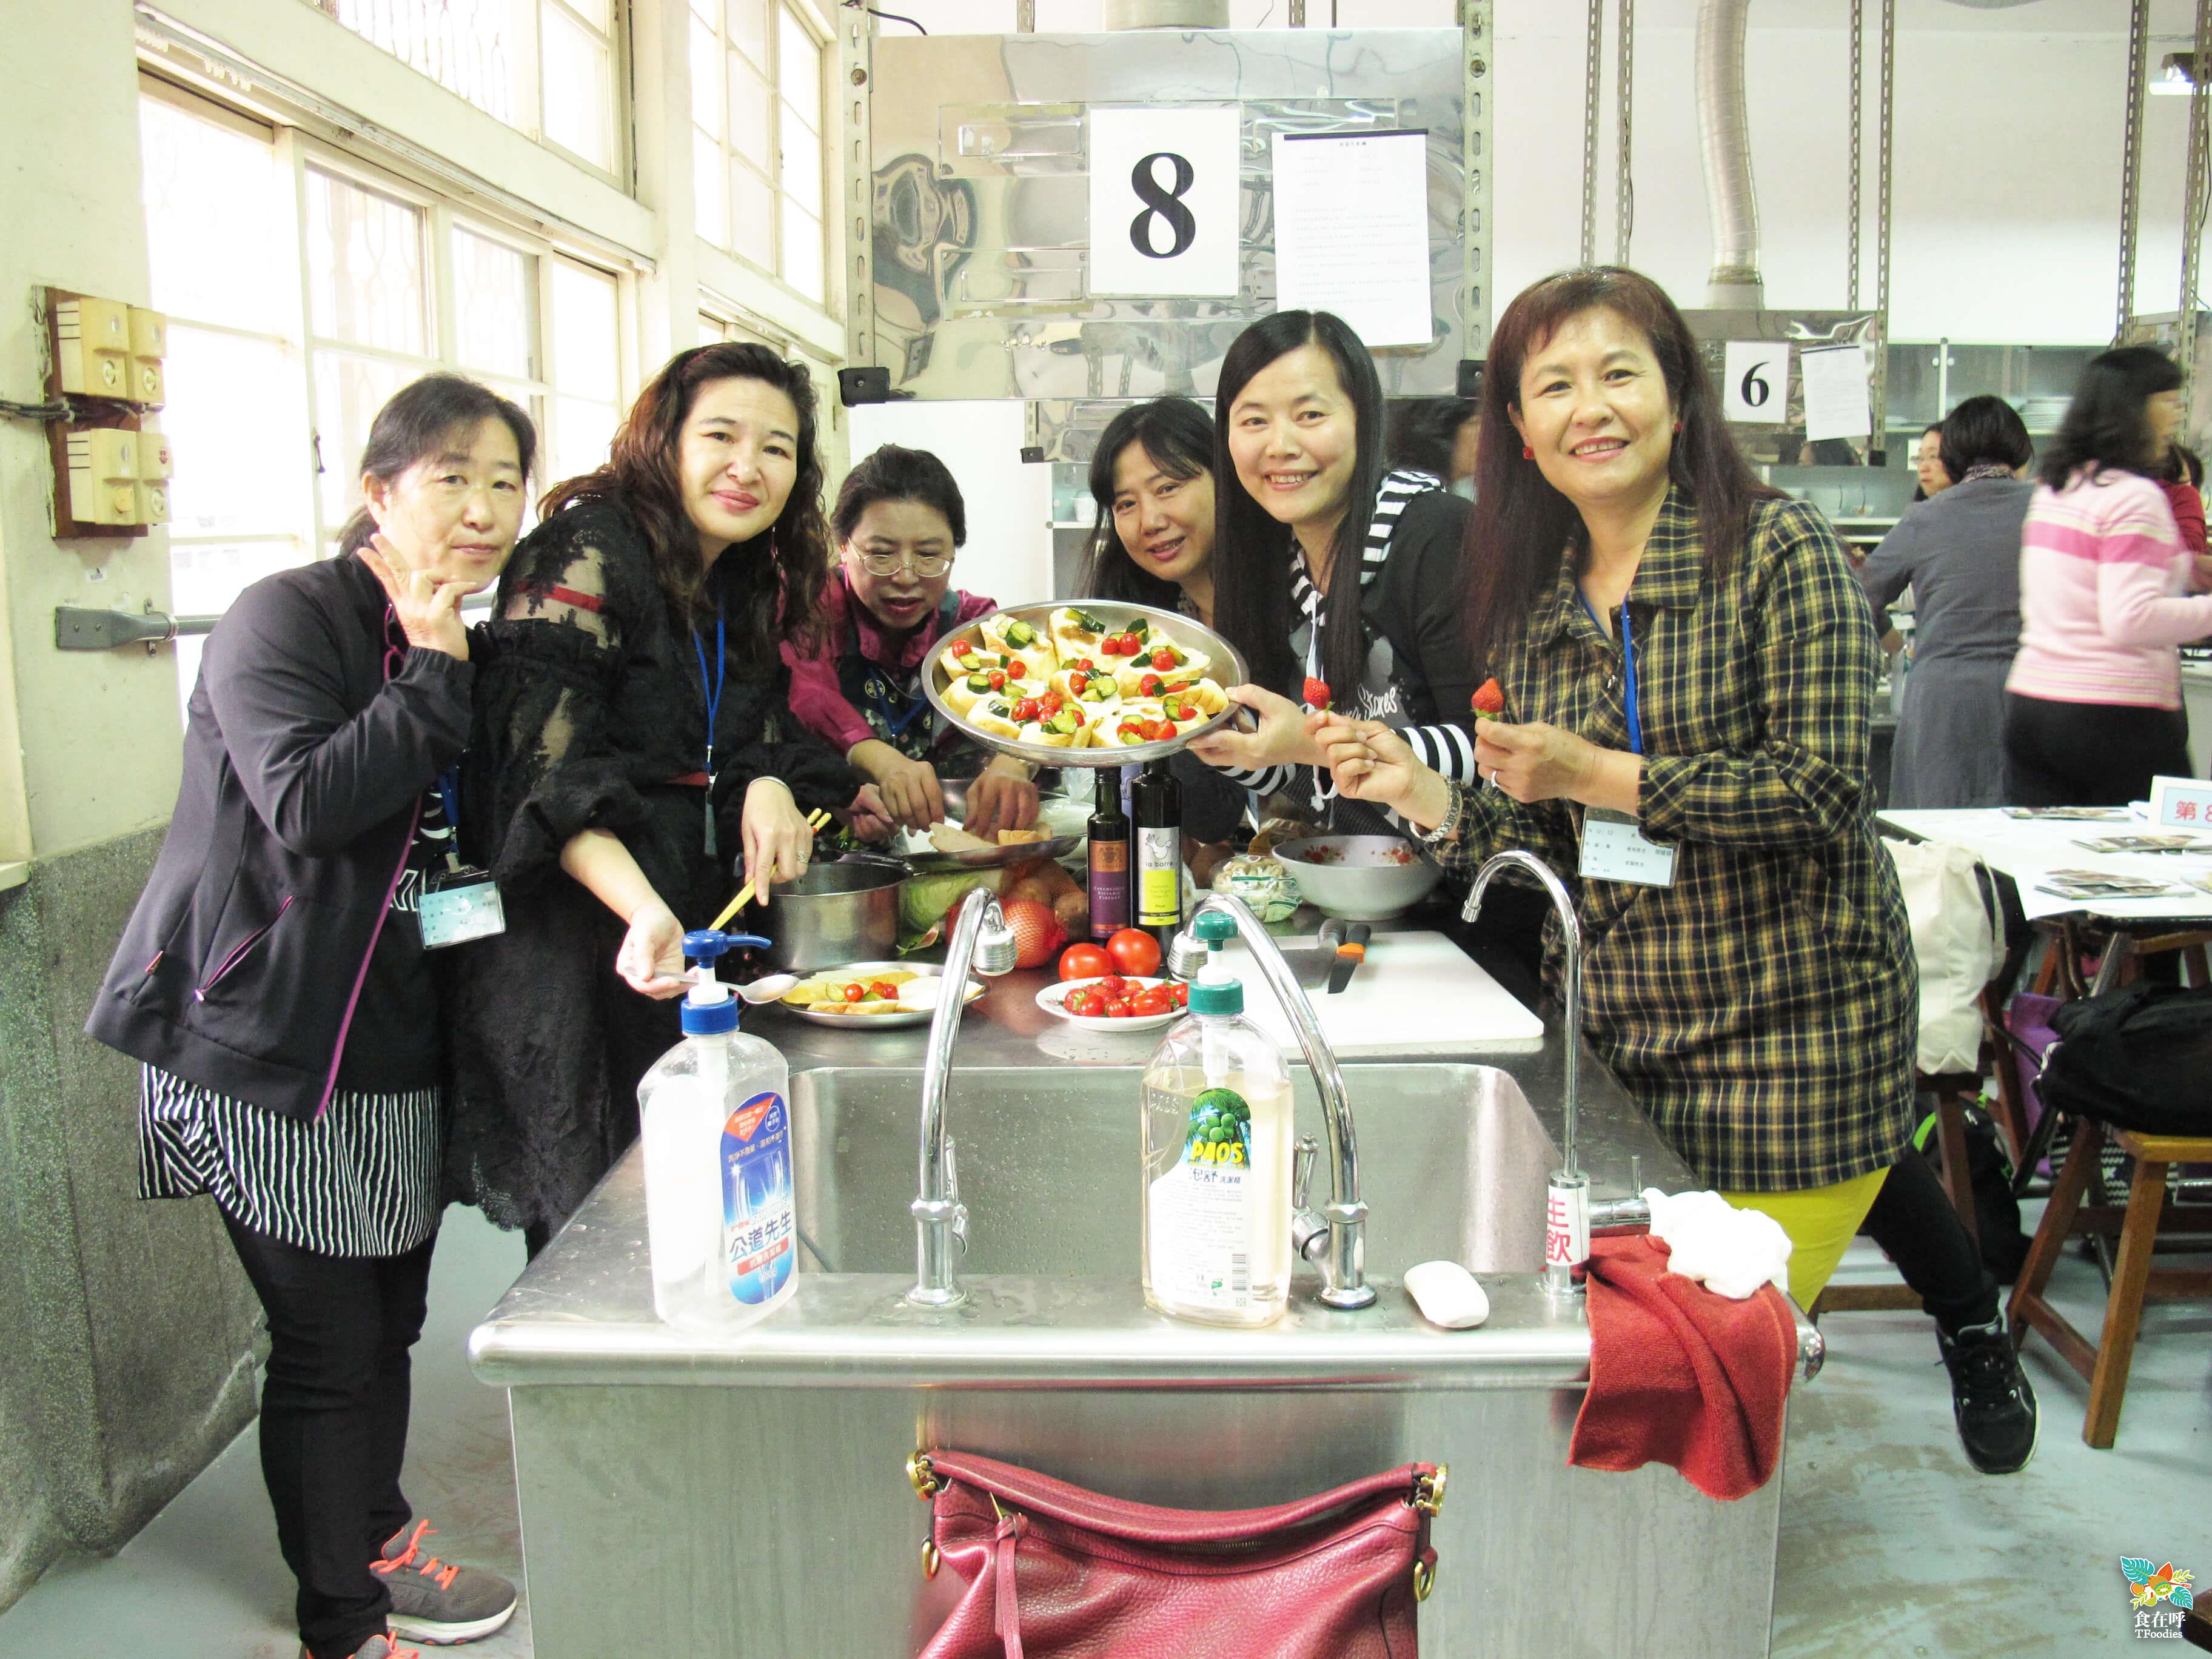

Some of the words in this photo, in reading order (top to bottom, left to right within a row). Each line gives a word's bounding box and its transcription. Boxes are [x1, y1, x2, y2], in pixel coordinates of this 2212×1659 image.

[1129, 153, 1196, 259] 8
[1741, 361, 1771, 407] 6
[1190, 1140, 1245, 1164] PAOS
[729, 1210, 792, 1262] 公道先生
